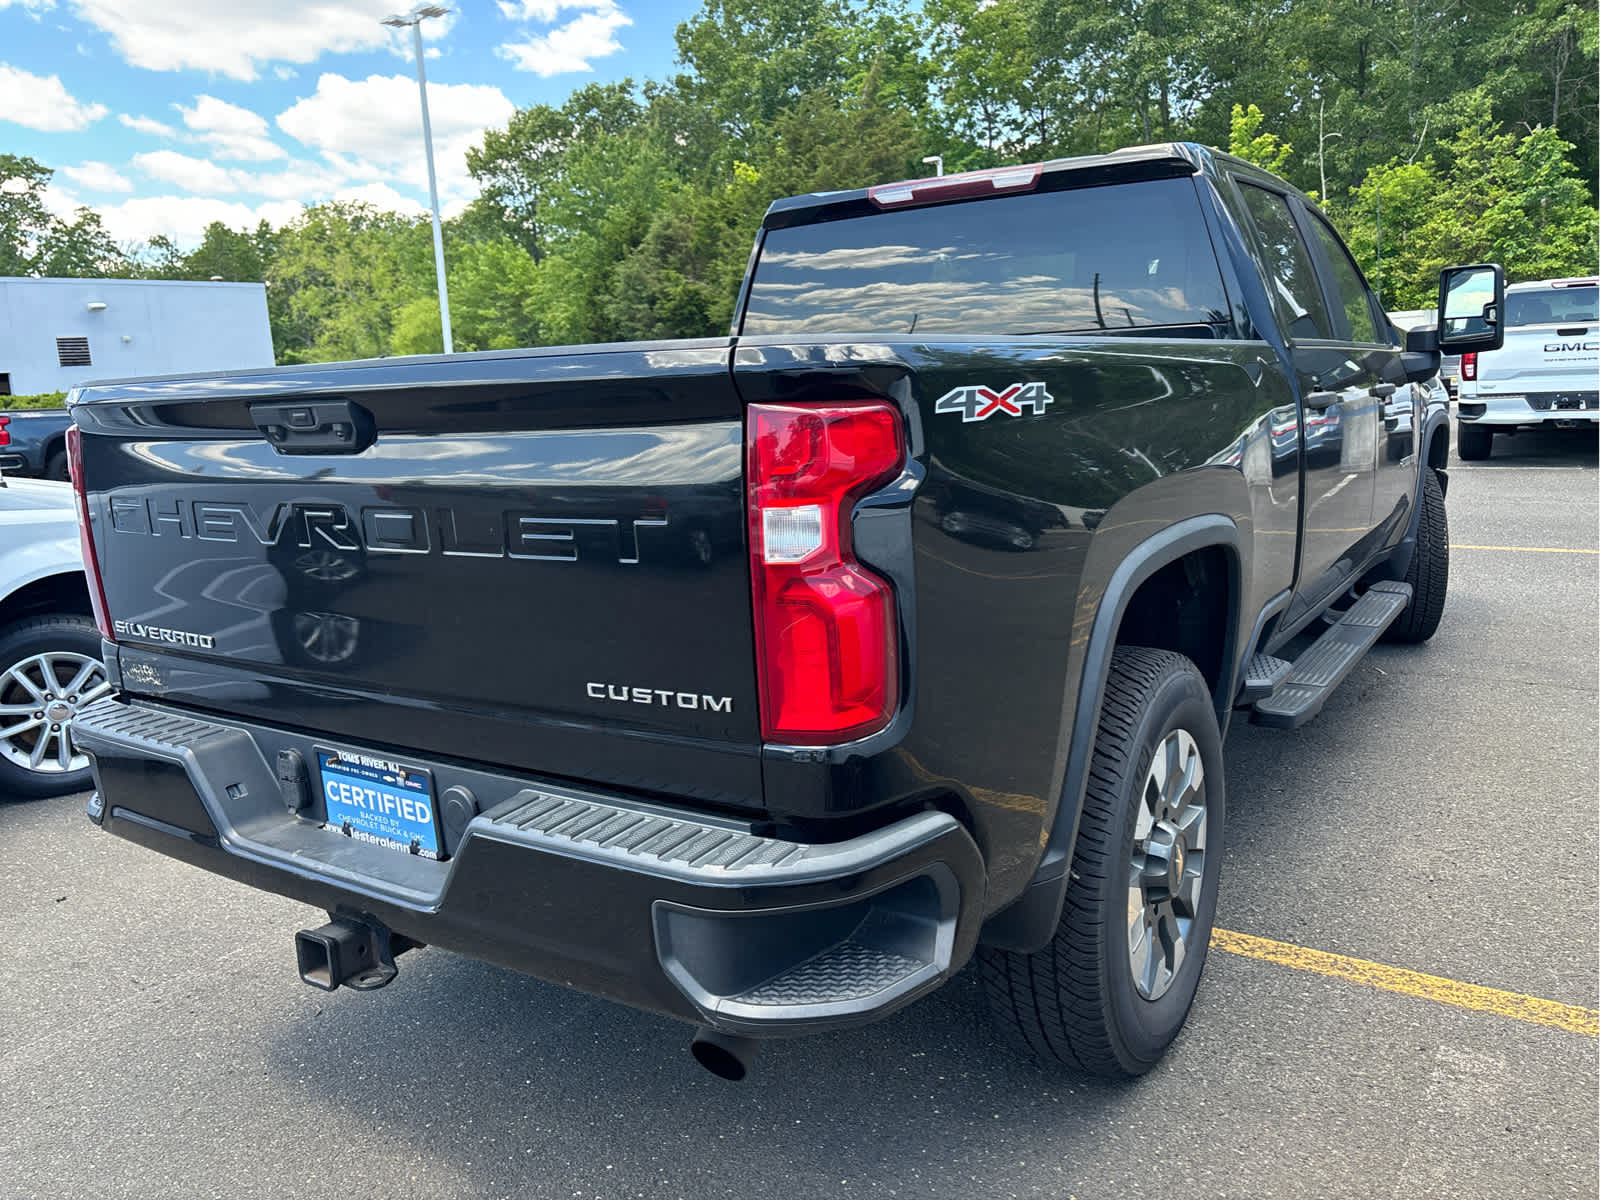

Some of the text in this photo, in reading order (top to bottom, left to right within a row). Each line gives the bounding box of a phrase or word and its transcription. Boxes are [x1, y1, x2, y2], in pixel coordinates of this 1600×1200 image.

[1543, 341, 1599, 352] GMC
[108, 495, 668, 563] CHEVROLET
[115, 620, 215, 648] SILVERADO
[586, 682, 732, 713] CUSTOM
[337, 751, 361, 765] TOMS
[388, 760, 401, 774] NJ
[326, 780, 430, 824] CERTIFIED
[337, 813, 425, 842] CHEVROLET BUICK & GMC
[360, 811, 399, 827] BACKED BY
